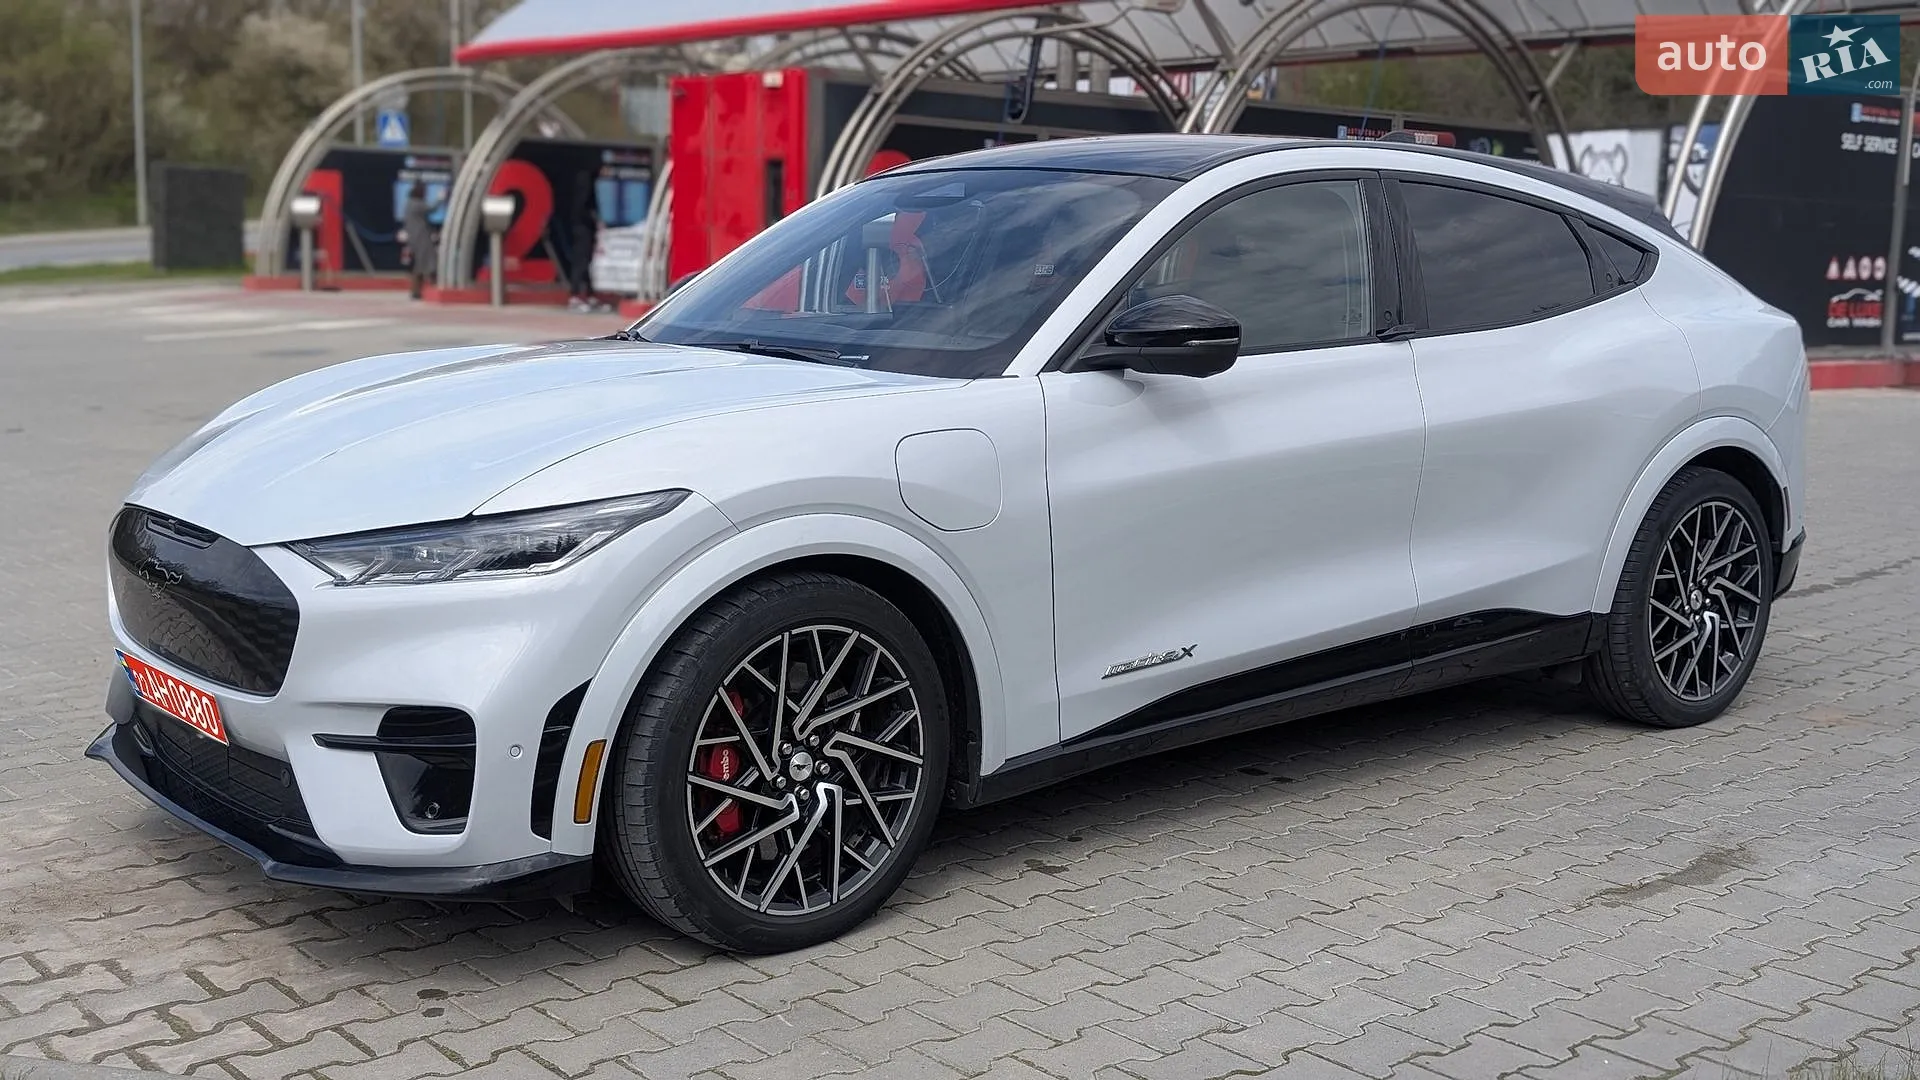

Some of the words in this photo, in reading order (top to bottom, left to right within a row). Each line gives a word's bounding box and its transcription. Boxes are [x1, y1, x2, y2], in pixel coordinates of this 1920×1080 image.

[1864, 135, 1899, 155] SERVICE
[303, 168, 343, 272] 1
[476, 159, 558, 282] 2
[721, 749, 730, 781] embo
